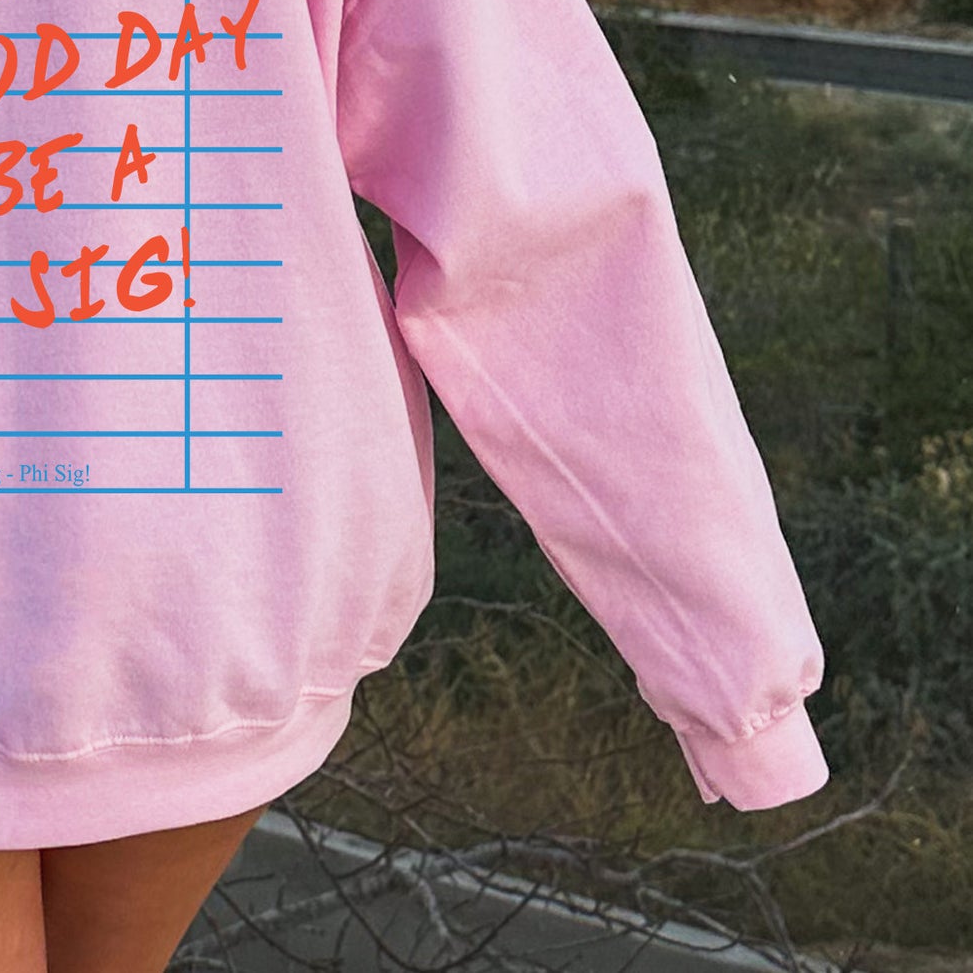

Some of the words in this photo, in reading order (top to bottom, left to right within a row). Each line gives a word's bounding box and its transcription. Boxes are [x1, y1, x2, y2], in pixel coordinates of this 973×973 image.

[110, 123, 157, 202] A
[10, 226, 196, 330] SIG!
[19, 463, 48, 482] Phi
[54, 464, 91, 487] Sig!
